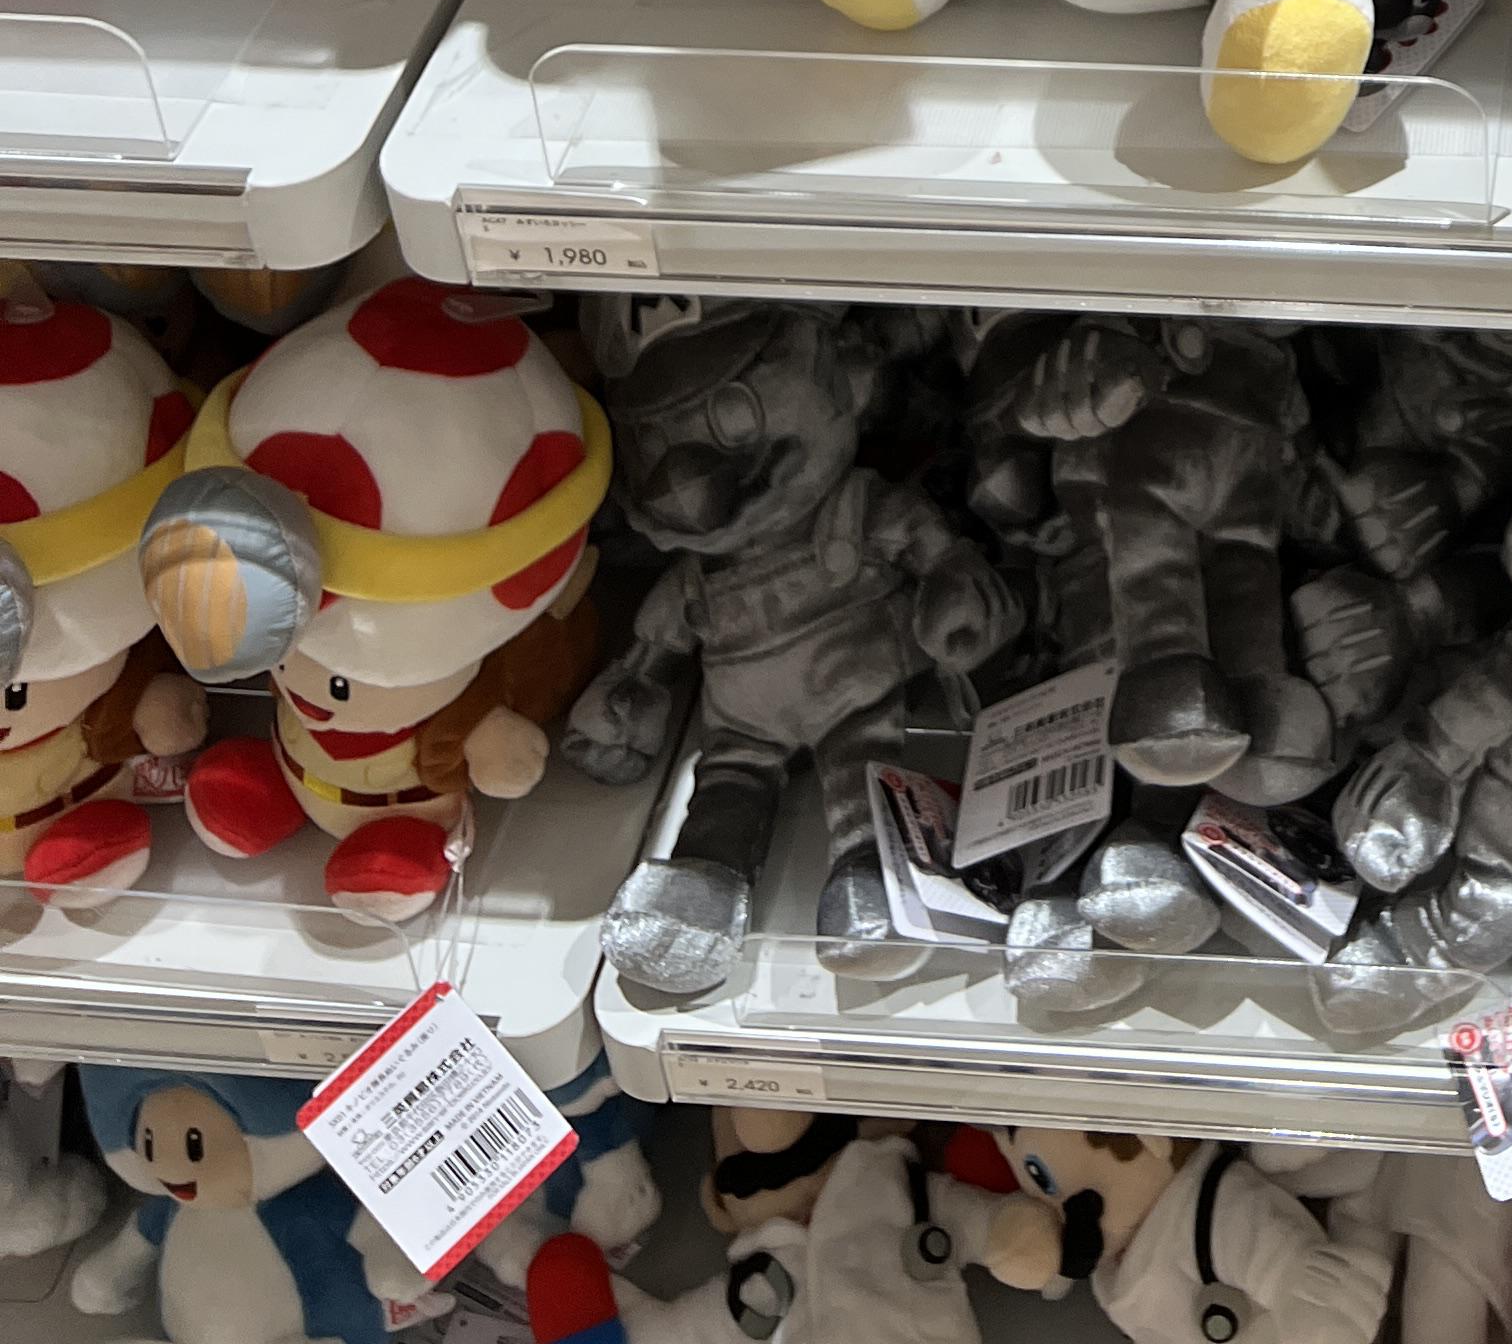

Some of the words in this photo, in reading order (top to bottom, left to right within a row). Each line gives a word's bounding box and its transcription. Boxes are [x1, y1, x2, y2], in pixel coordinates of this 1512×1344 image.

[509, 249, 520, 261] ¥
[544, 247, 607, 266] 1,980
[444, 1108, 467, 1131] MADE
[464, 1101, 474, 1112] IN
[471, 1072, 504, 1104] VIETNAM
